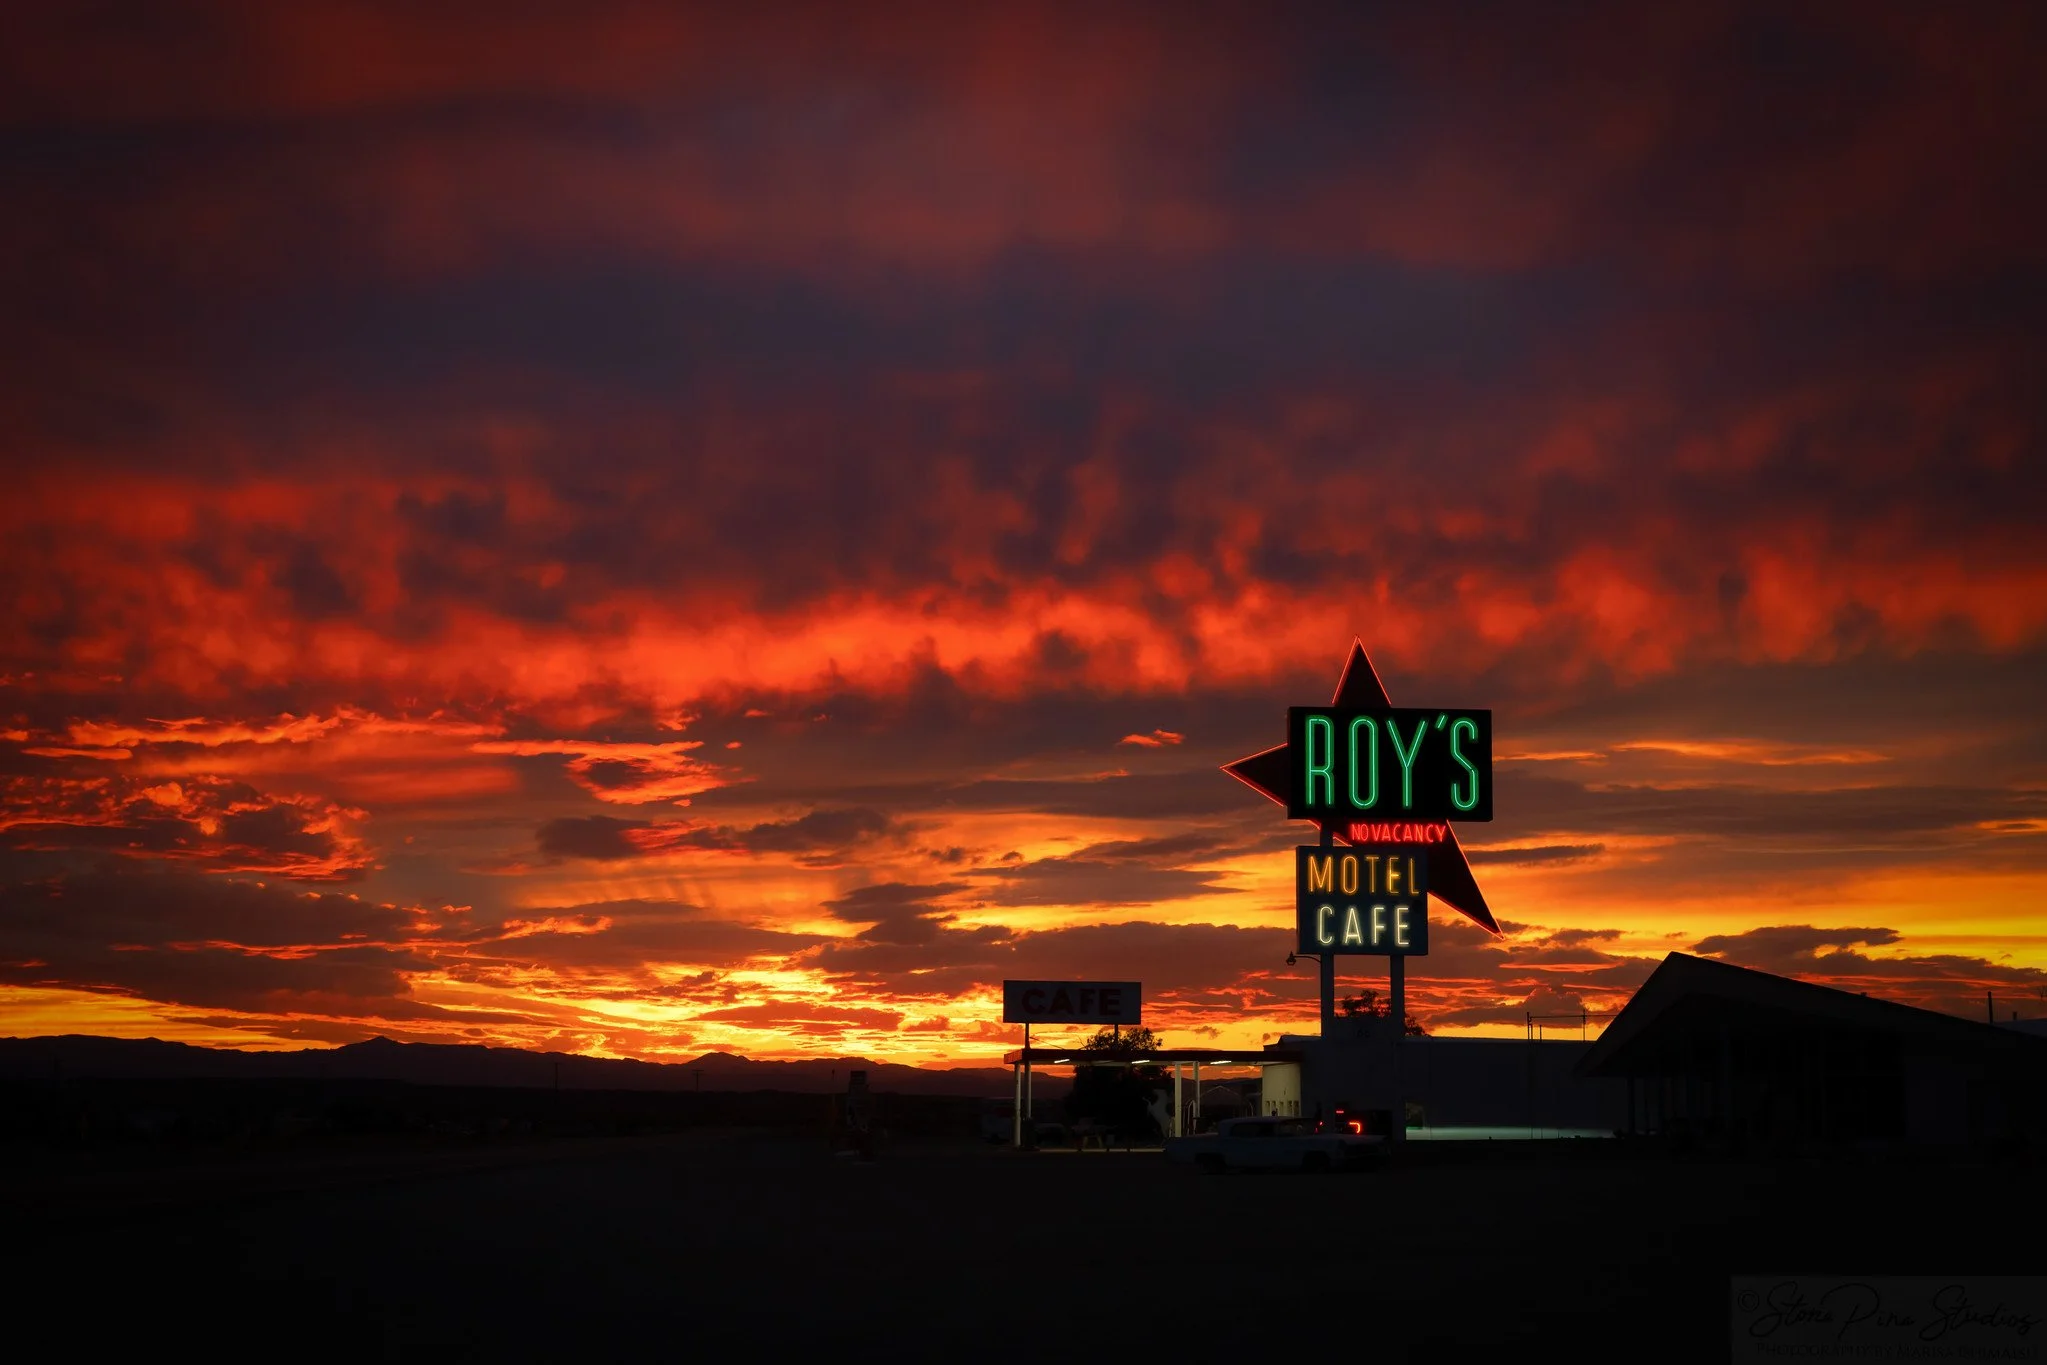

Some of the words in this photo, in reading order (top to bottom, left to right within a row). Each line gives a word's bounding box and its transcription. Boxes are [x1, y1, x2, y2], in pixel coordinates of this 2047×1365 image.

[1305, 711, 1480, 810] ROY'S
[1308, 855, 1420, 894] MOTEL
[1317, 905, 1411, 946] CAFE
[1022, 988, 1121, 1016] CAFE
